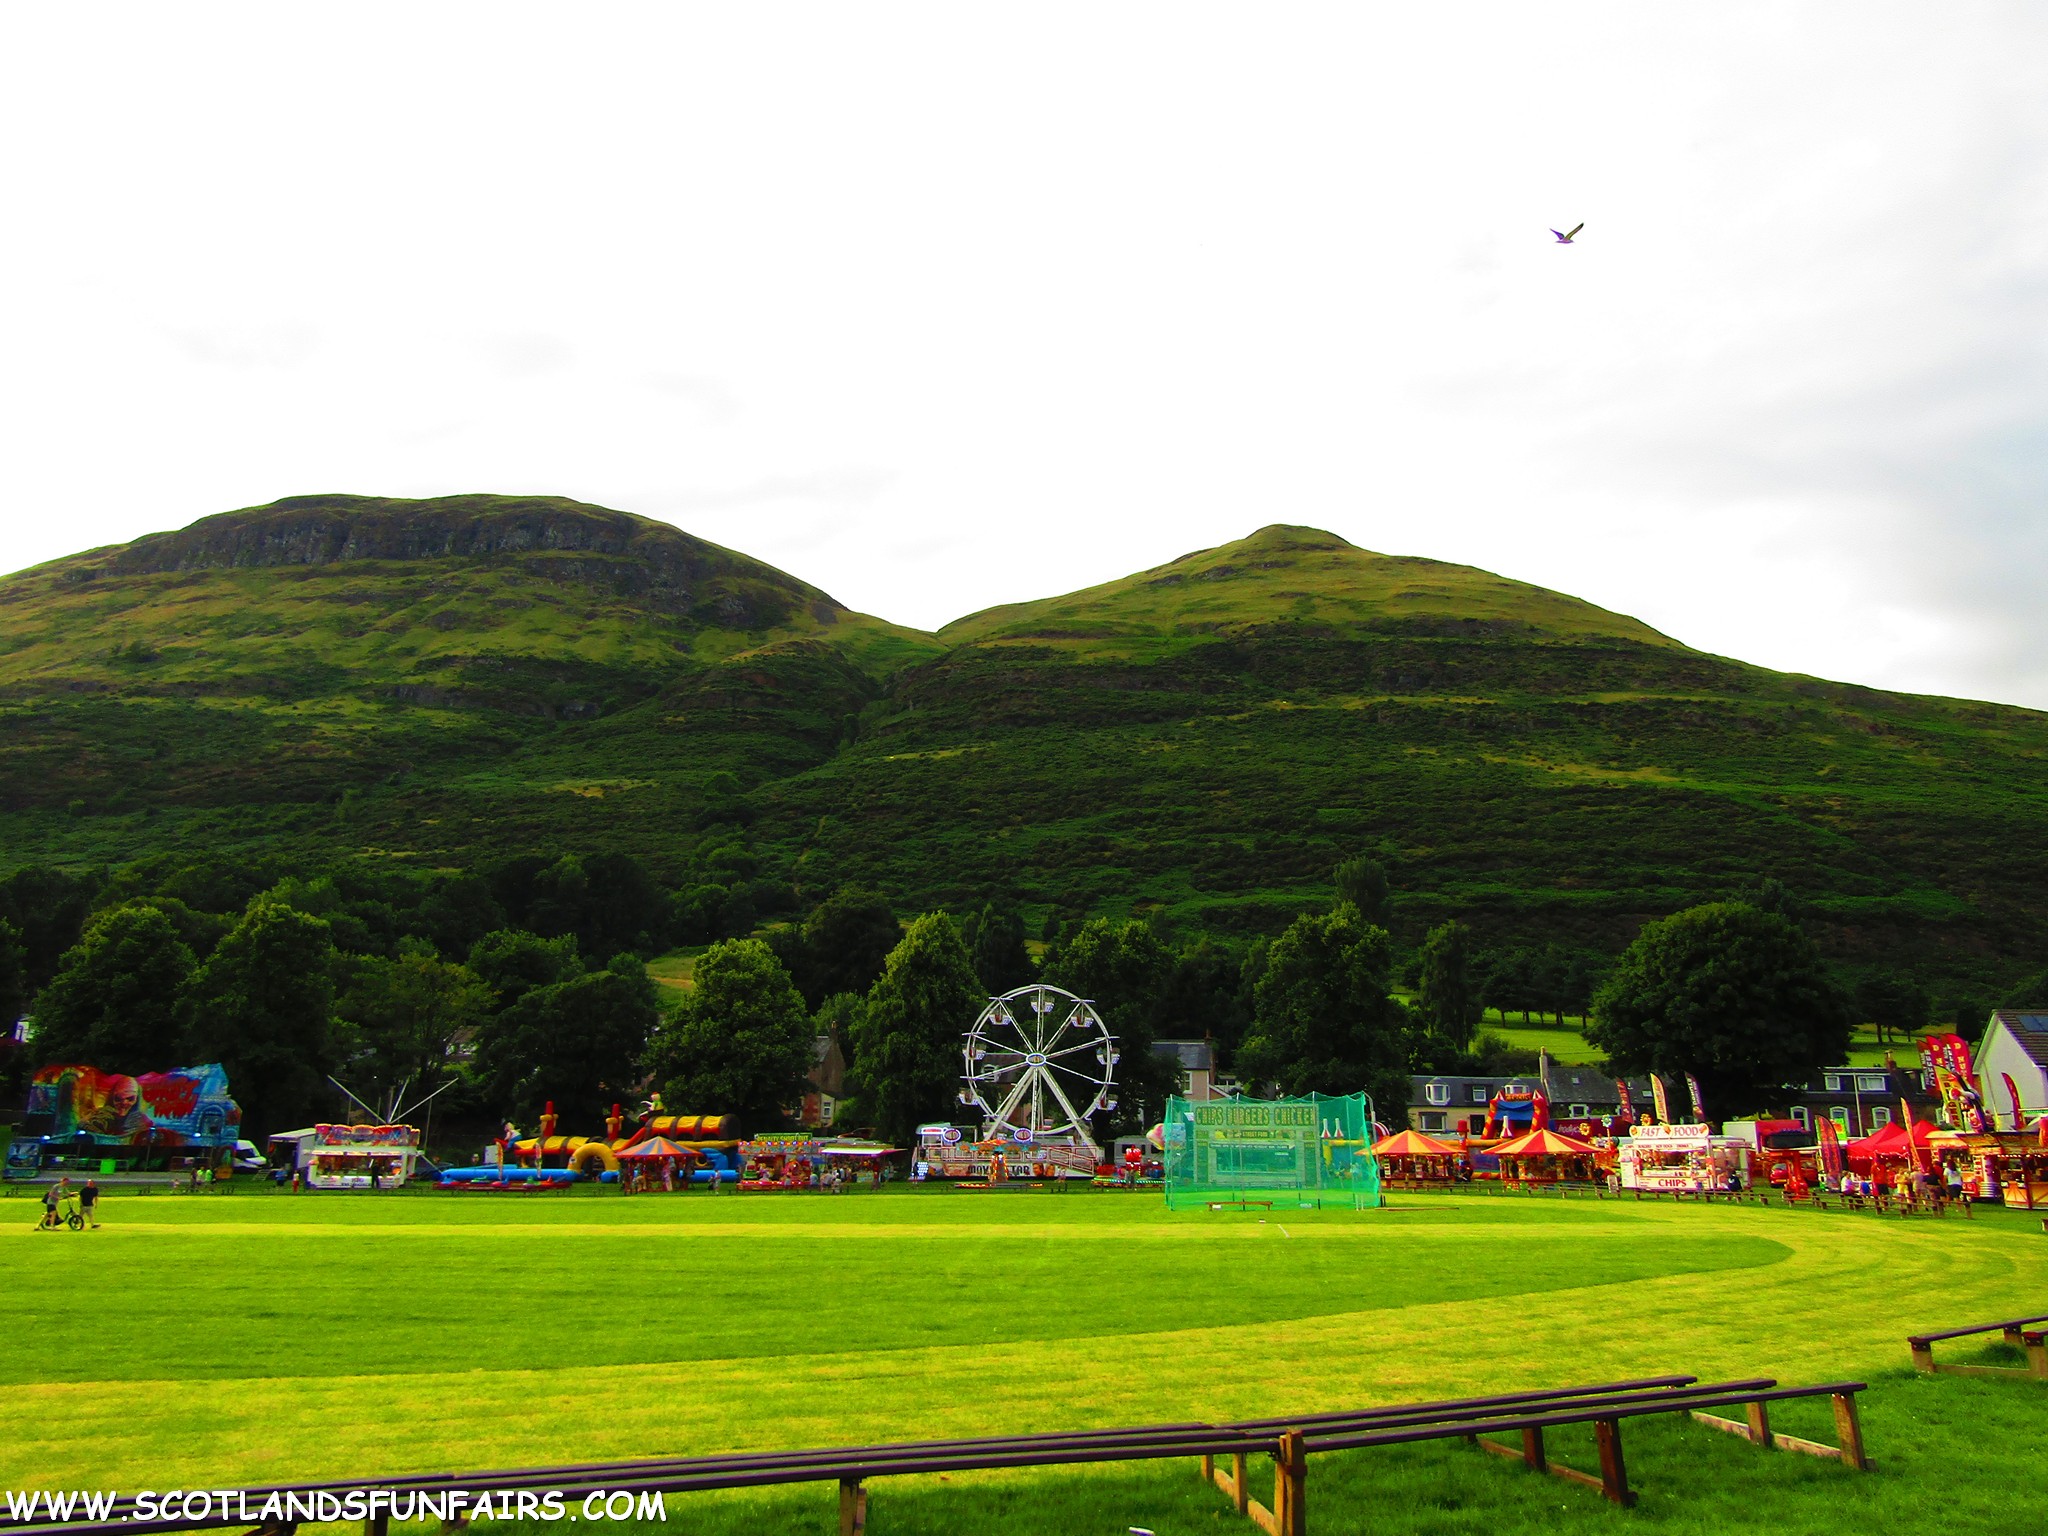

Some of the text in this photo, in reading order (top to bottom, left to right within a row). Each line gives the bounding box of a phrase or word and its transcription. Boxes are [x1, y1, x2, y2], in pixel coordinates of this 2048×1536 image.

[1195, 1105, 1316, 1125] CHIPS BURGERS CHICKEN
[1641, 1126, 1699, 1137] FAST FOOD
[1007, 1164, 1030, 1175] TAR
[1658, 1179, 1687, 1187] CHIPS
